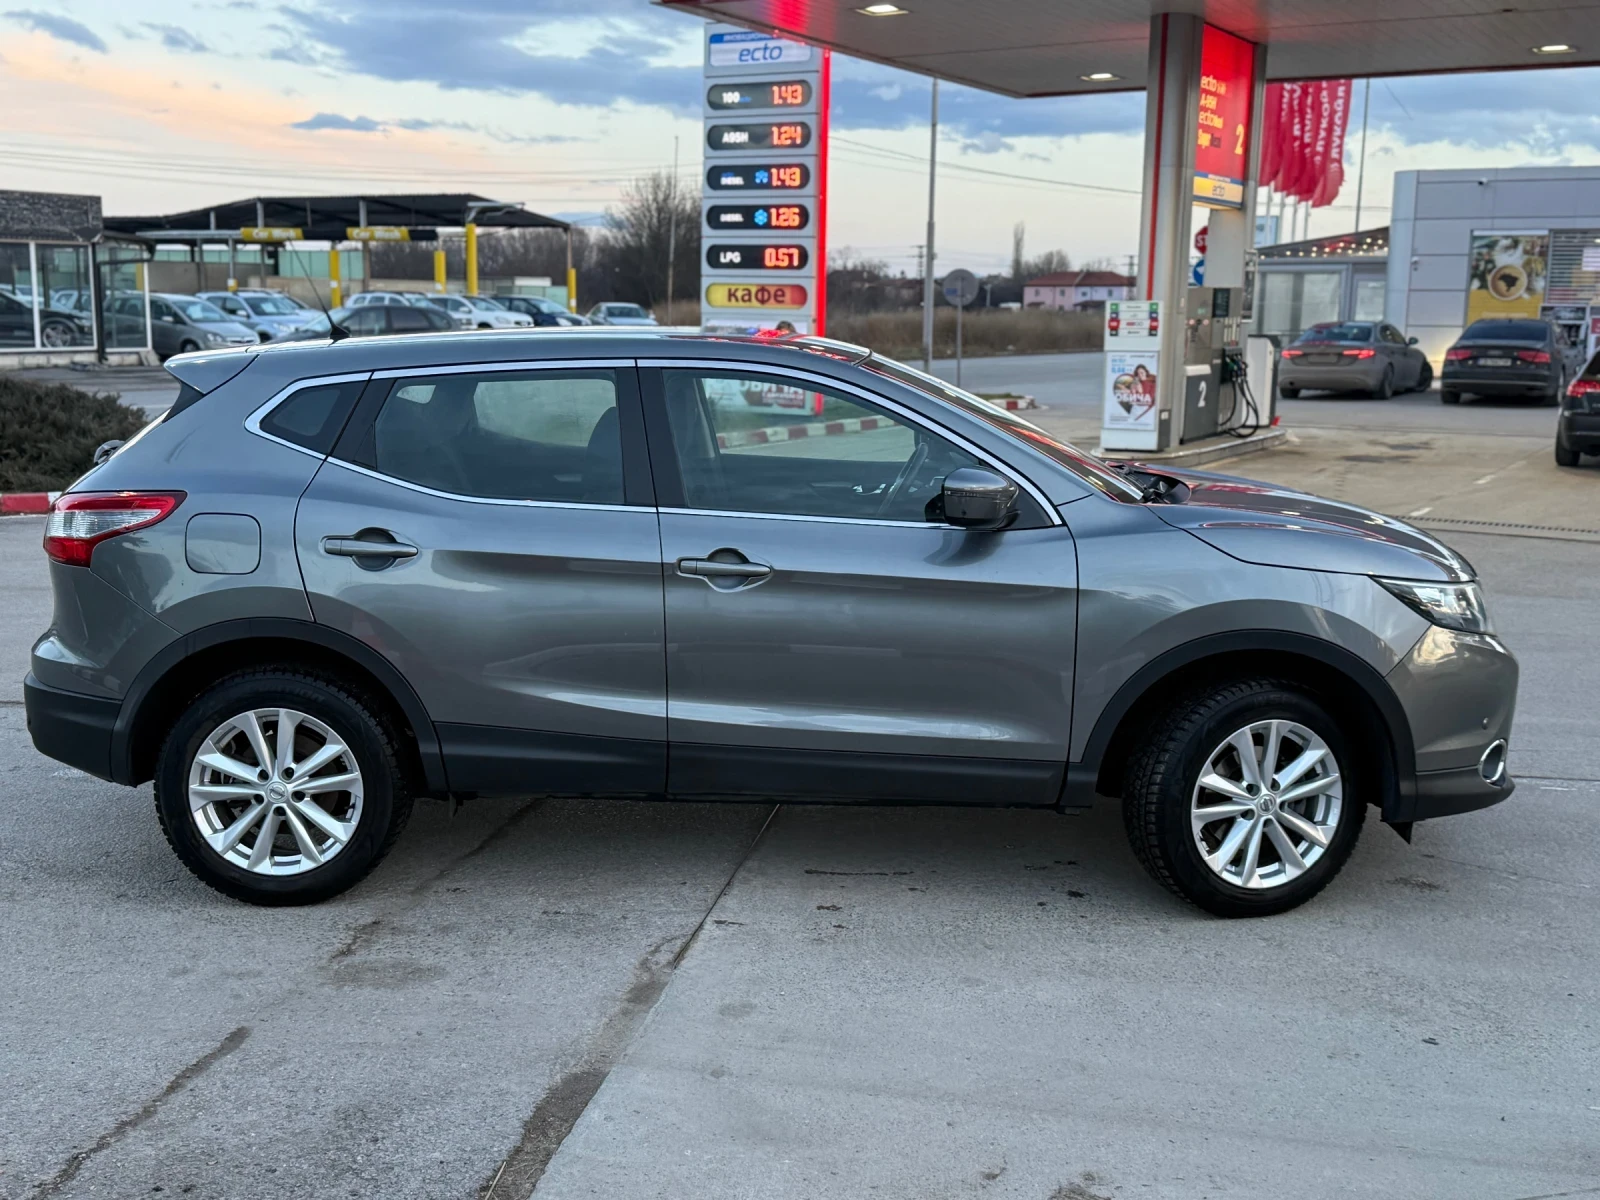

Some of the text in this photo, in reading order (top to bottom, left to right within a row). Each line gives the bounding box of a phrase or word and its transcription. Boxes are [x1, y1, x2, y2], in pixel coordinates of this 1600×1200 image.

[738, 43, 783, 62] ecto
[771, 84, 803, 105] 1.43
[771, 125, 802, 146] 1.24
[1234, 123, 1245, 155] 2
[770, 166, 801, 187] 1.43
[769, 206, 801, 227] 1.26
[719, 247, 800, 268] LPG 0.57
[727, 285, 787, 306] кафе
[1197, 380, 1207, 407] 2
